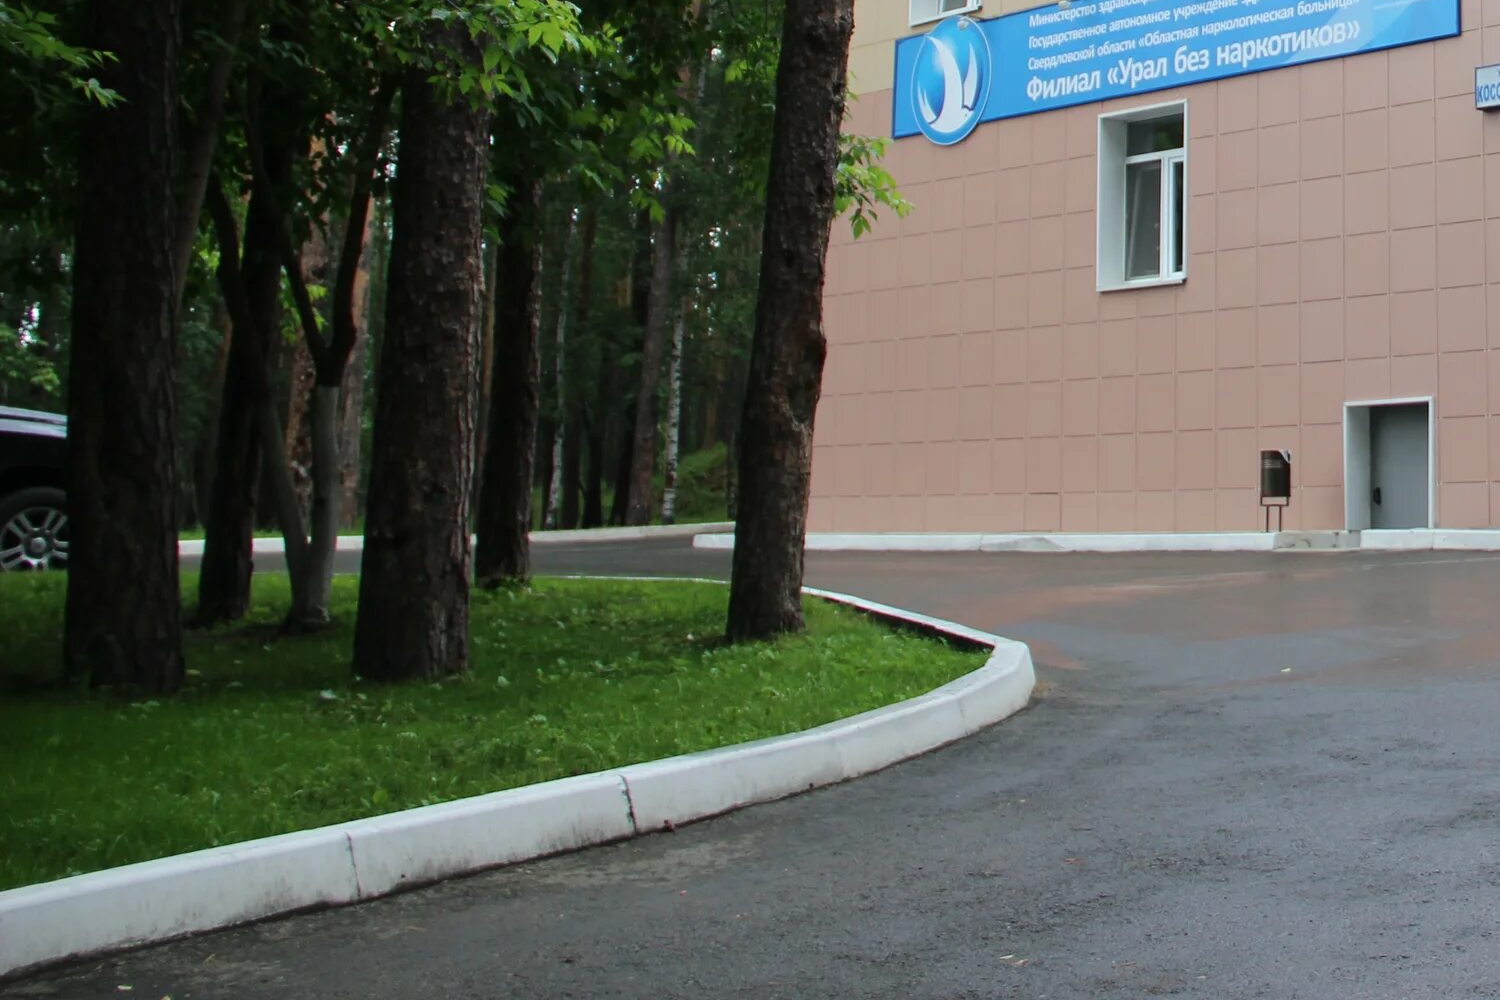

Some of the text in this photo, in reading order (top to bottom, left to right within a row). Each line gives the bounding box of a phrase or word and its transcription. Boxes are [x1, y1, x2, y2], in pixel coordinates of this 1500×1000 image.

[1028, 45, 1095, 70] Свердловской
[1097, 37, 1136, 57] области
[1138, 26, 1199, 48] «Областная
[1201, 7, 1294, 36] наркологическая
[1029, 3, 1096, 27] Министерство
[1029, 24, 1107, 49] Государственное
[1109, 9, 1170, 31] автономное
[1027, 20, 1360, 101] Филиал «Урал без наркотиков»
